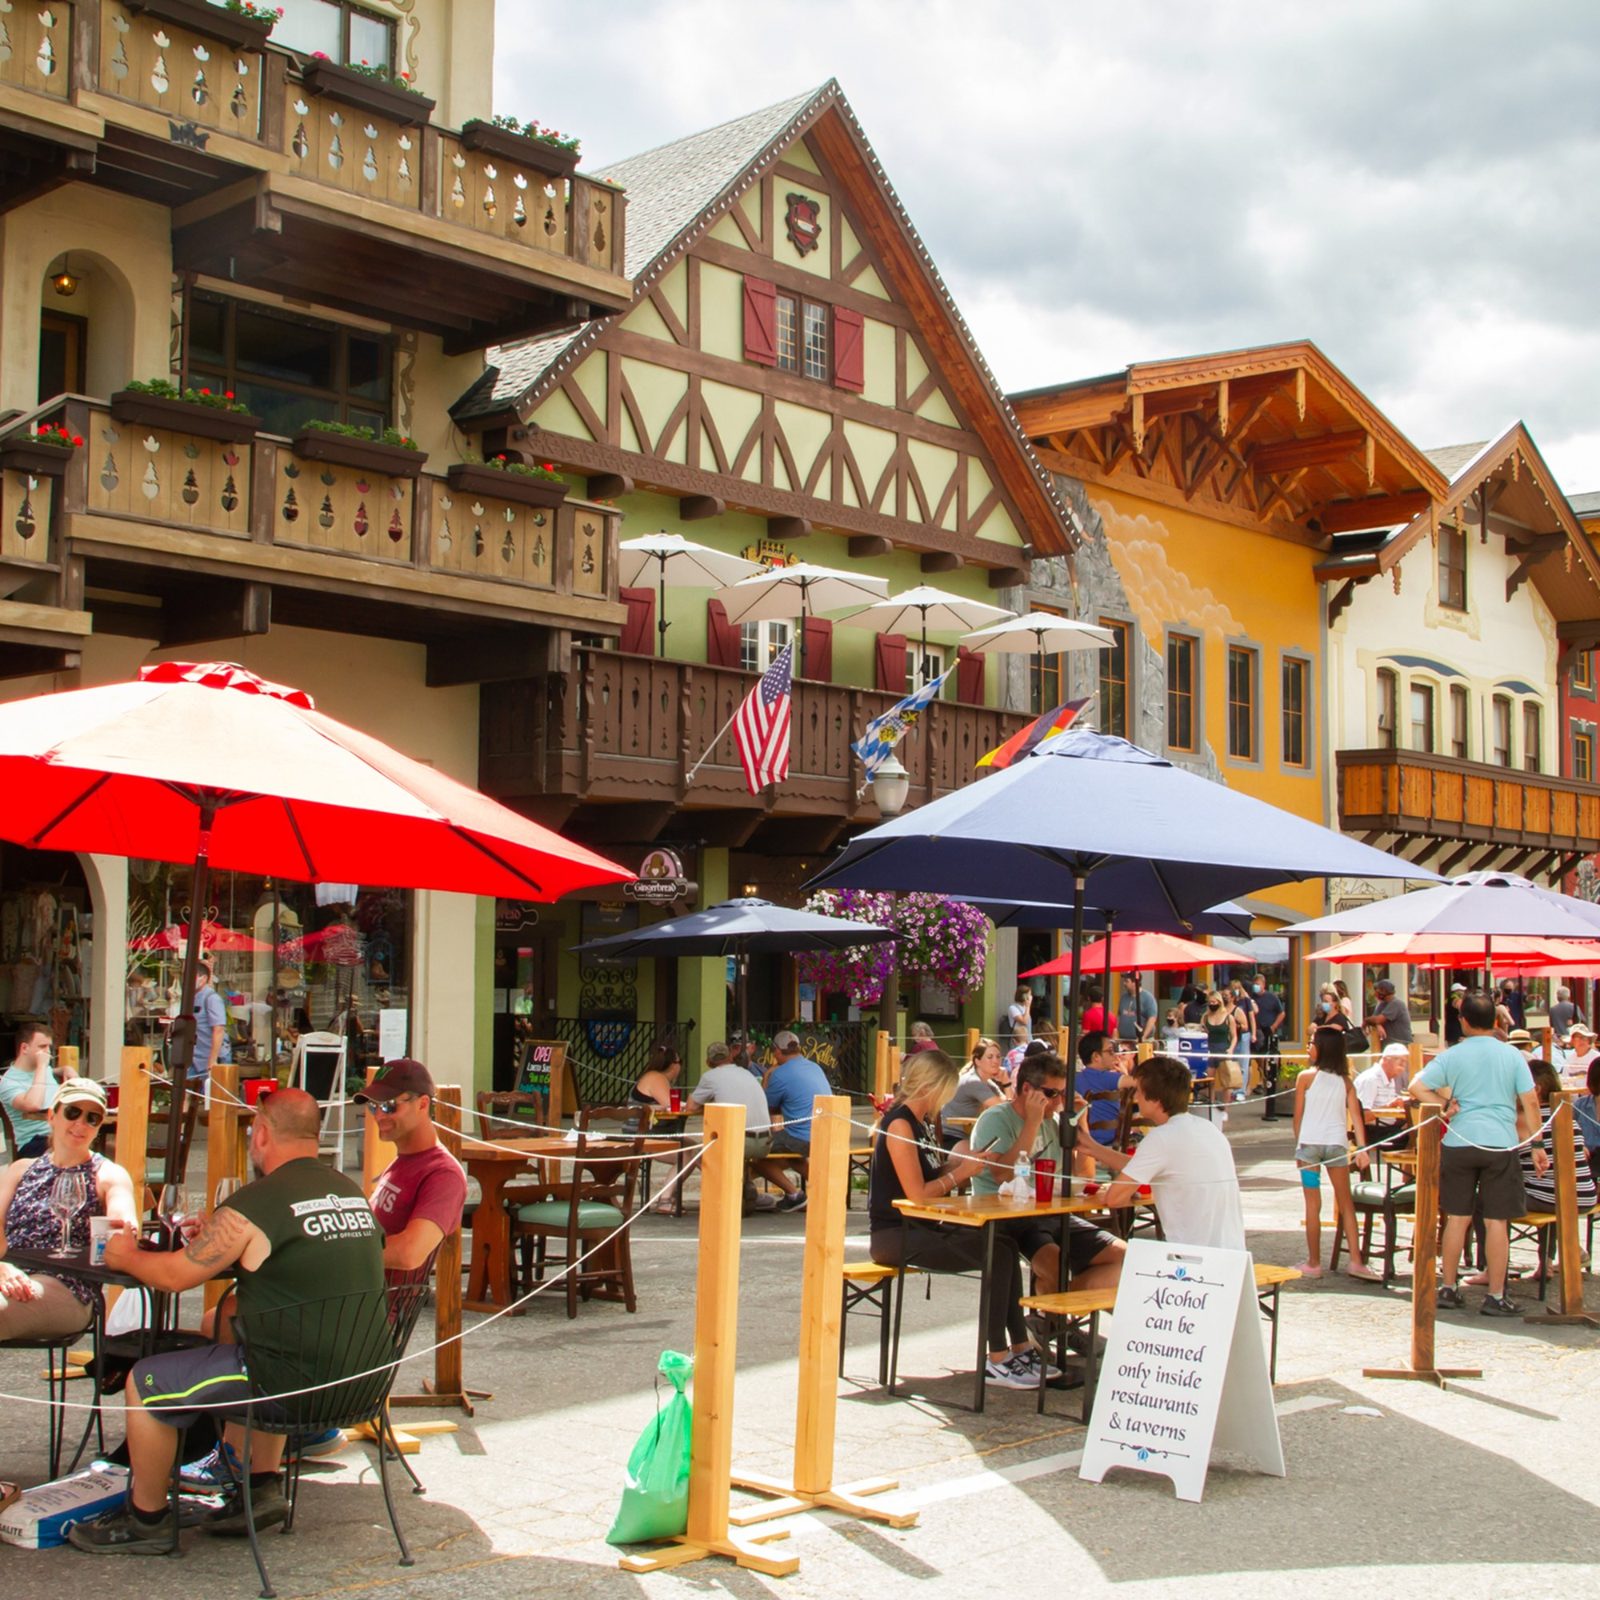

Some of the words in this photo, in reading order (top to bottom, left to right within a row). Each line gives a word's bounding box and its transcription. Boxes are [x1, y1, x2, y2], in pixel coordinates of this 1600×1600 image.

[303, 1211, 376, 1236] GRUBER
[323, 1232, 338, 1242] LAW
[339, 1230, 362, 1239] OFFICES
[1143, 1287, 1209, 1310] Alcohol
[1145, 1316, 1173, 1332] can
[1178, 1315, 1195, 1335] be
[1126, 1339, 1207, 1363] consumed
[1118, 1361, 1151, 1388] only
[1155, 1365, 1202, 1389] inside
[1111, 1389, 1199, 1416] restaurants
[1109, 1411, 1122, 1430] &
[1126, 1417, 1186, 1441] taverns
